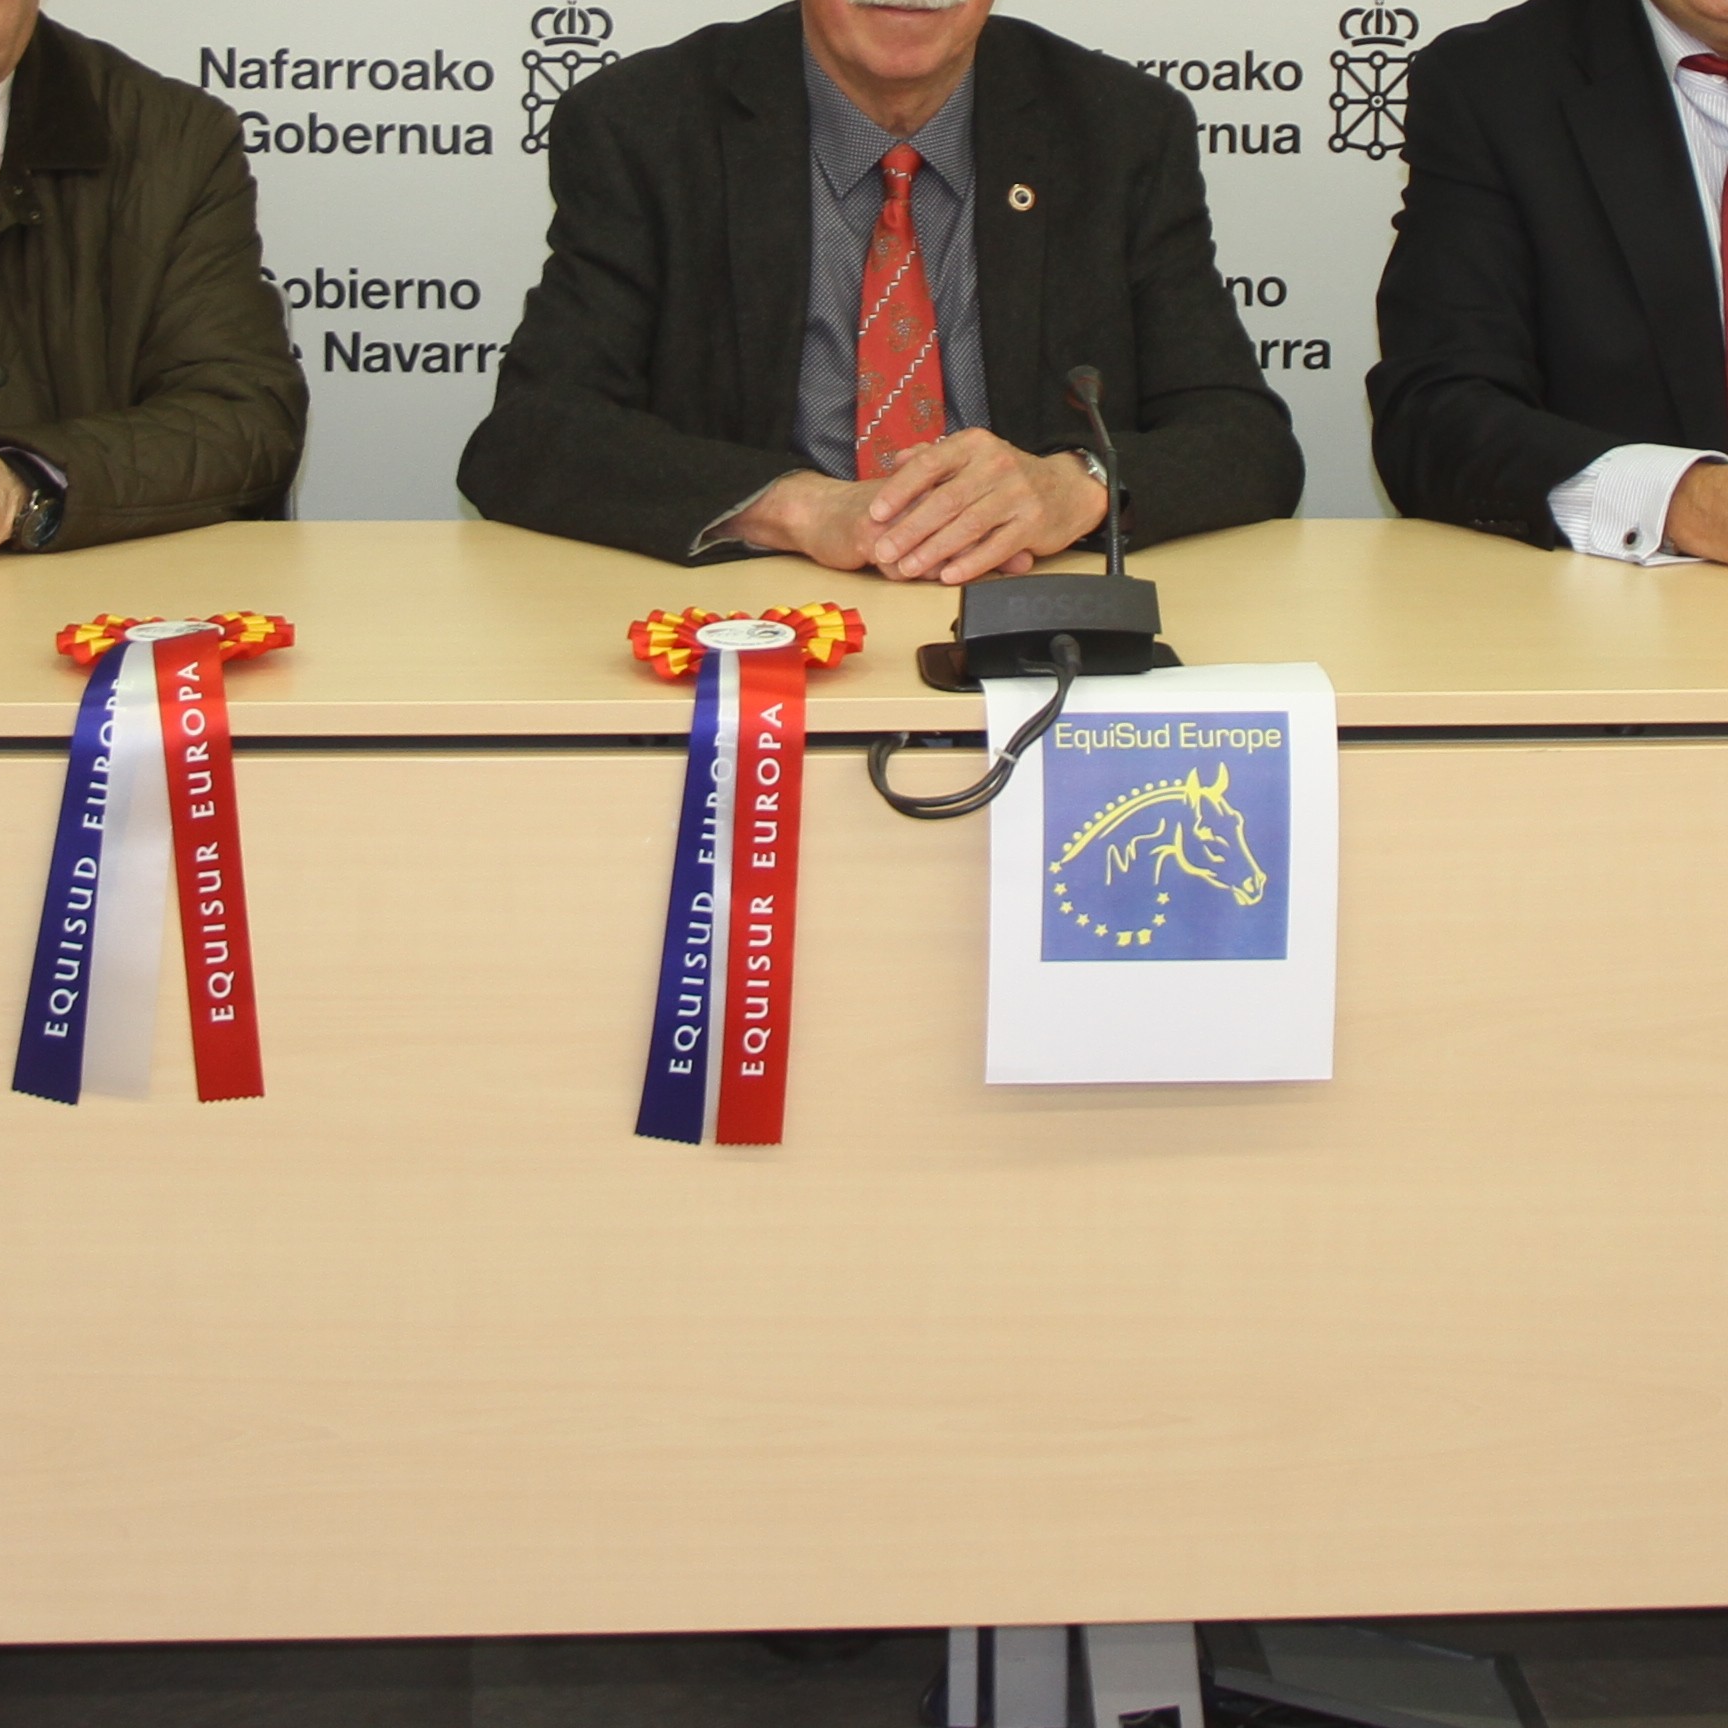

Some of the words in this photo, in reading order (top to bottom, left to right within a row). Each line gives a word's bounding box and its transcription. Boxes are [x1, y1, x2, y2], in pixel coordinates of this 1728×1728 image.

[200, 47, 495, 91] Nafarroako
[238, 111, 494, 155] Gobernua
[261, 267, 481, 309] obierno
[324, 331, 509, 373] Navarr
[1007, 592, 1118, 621] BOSCH
[177, 660, 215, 820] EUROPA
[751, 702, 784, 869] EUROPA
[1054, 722, 1171, 754] EquiSud
[1179, 722, 1282, 754] Europe
[43, 857, 98, 1039] EQUISUD
[195, 841, 235, 1023] EQUISUR
[668, 890, 714, 1076] EQUISUD
[741, 894, 775, 1078] EQUISUR
